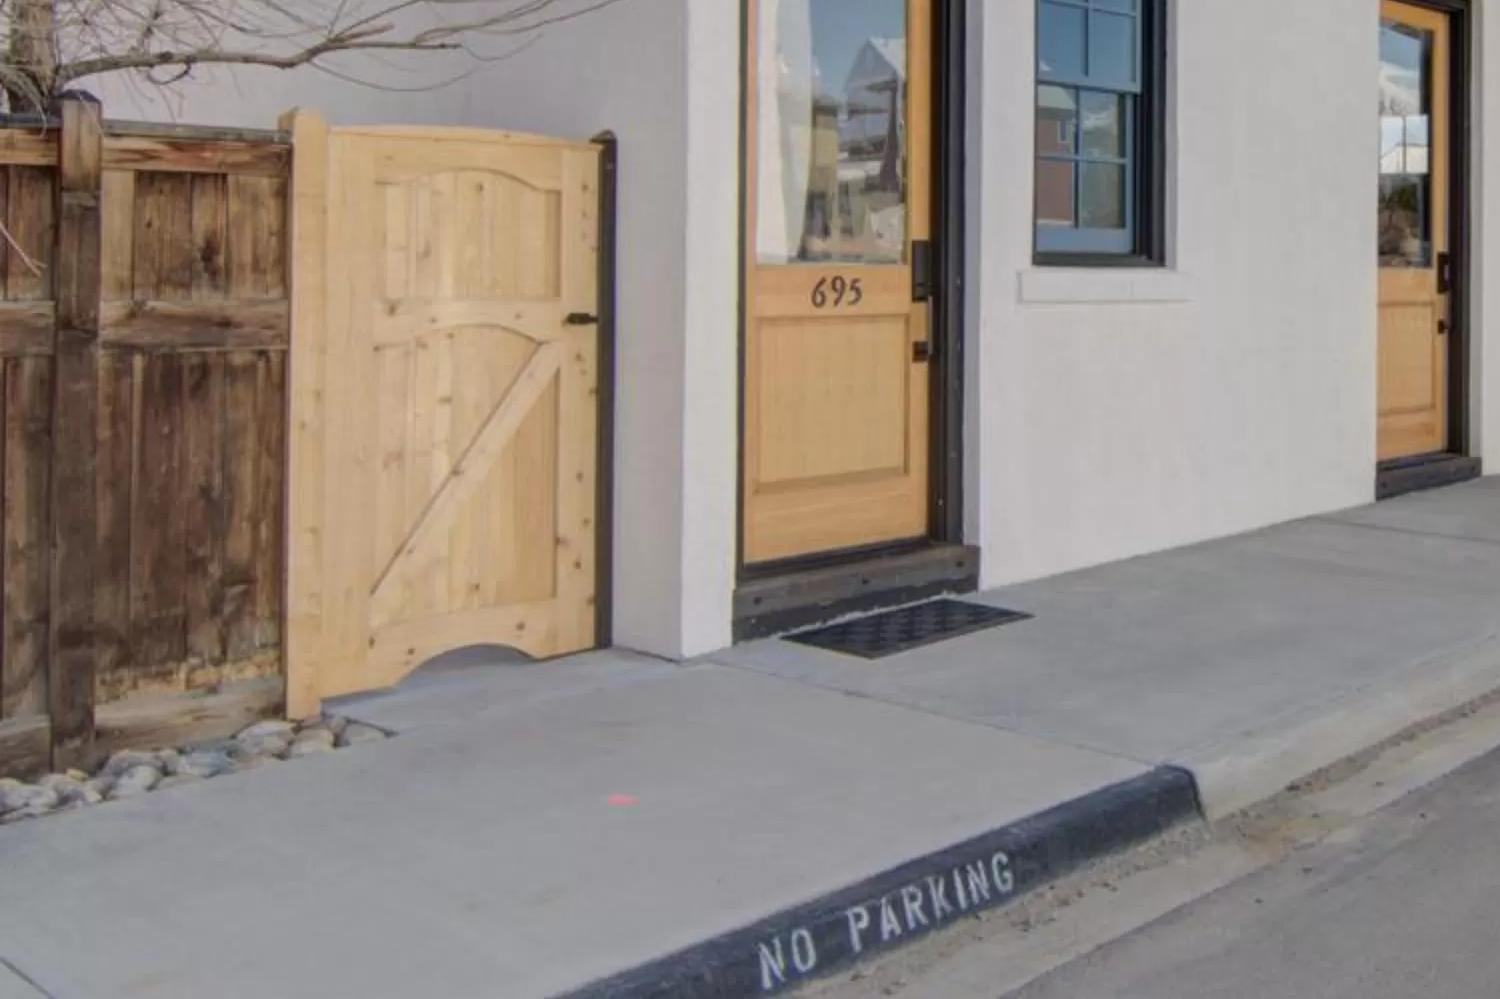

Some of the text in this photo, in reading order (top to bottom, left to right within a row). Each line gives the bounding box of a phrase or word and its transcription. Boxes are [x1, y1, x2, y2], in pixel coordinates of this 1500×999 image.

[811, 275, 862, 309] 695
[757, 851, 1014, 990] NO PARKING
